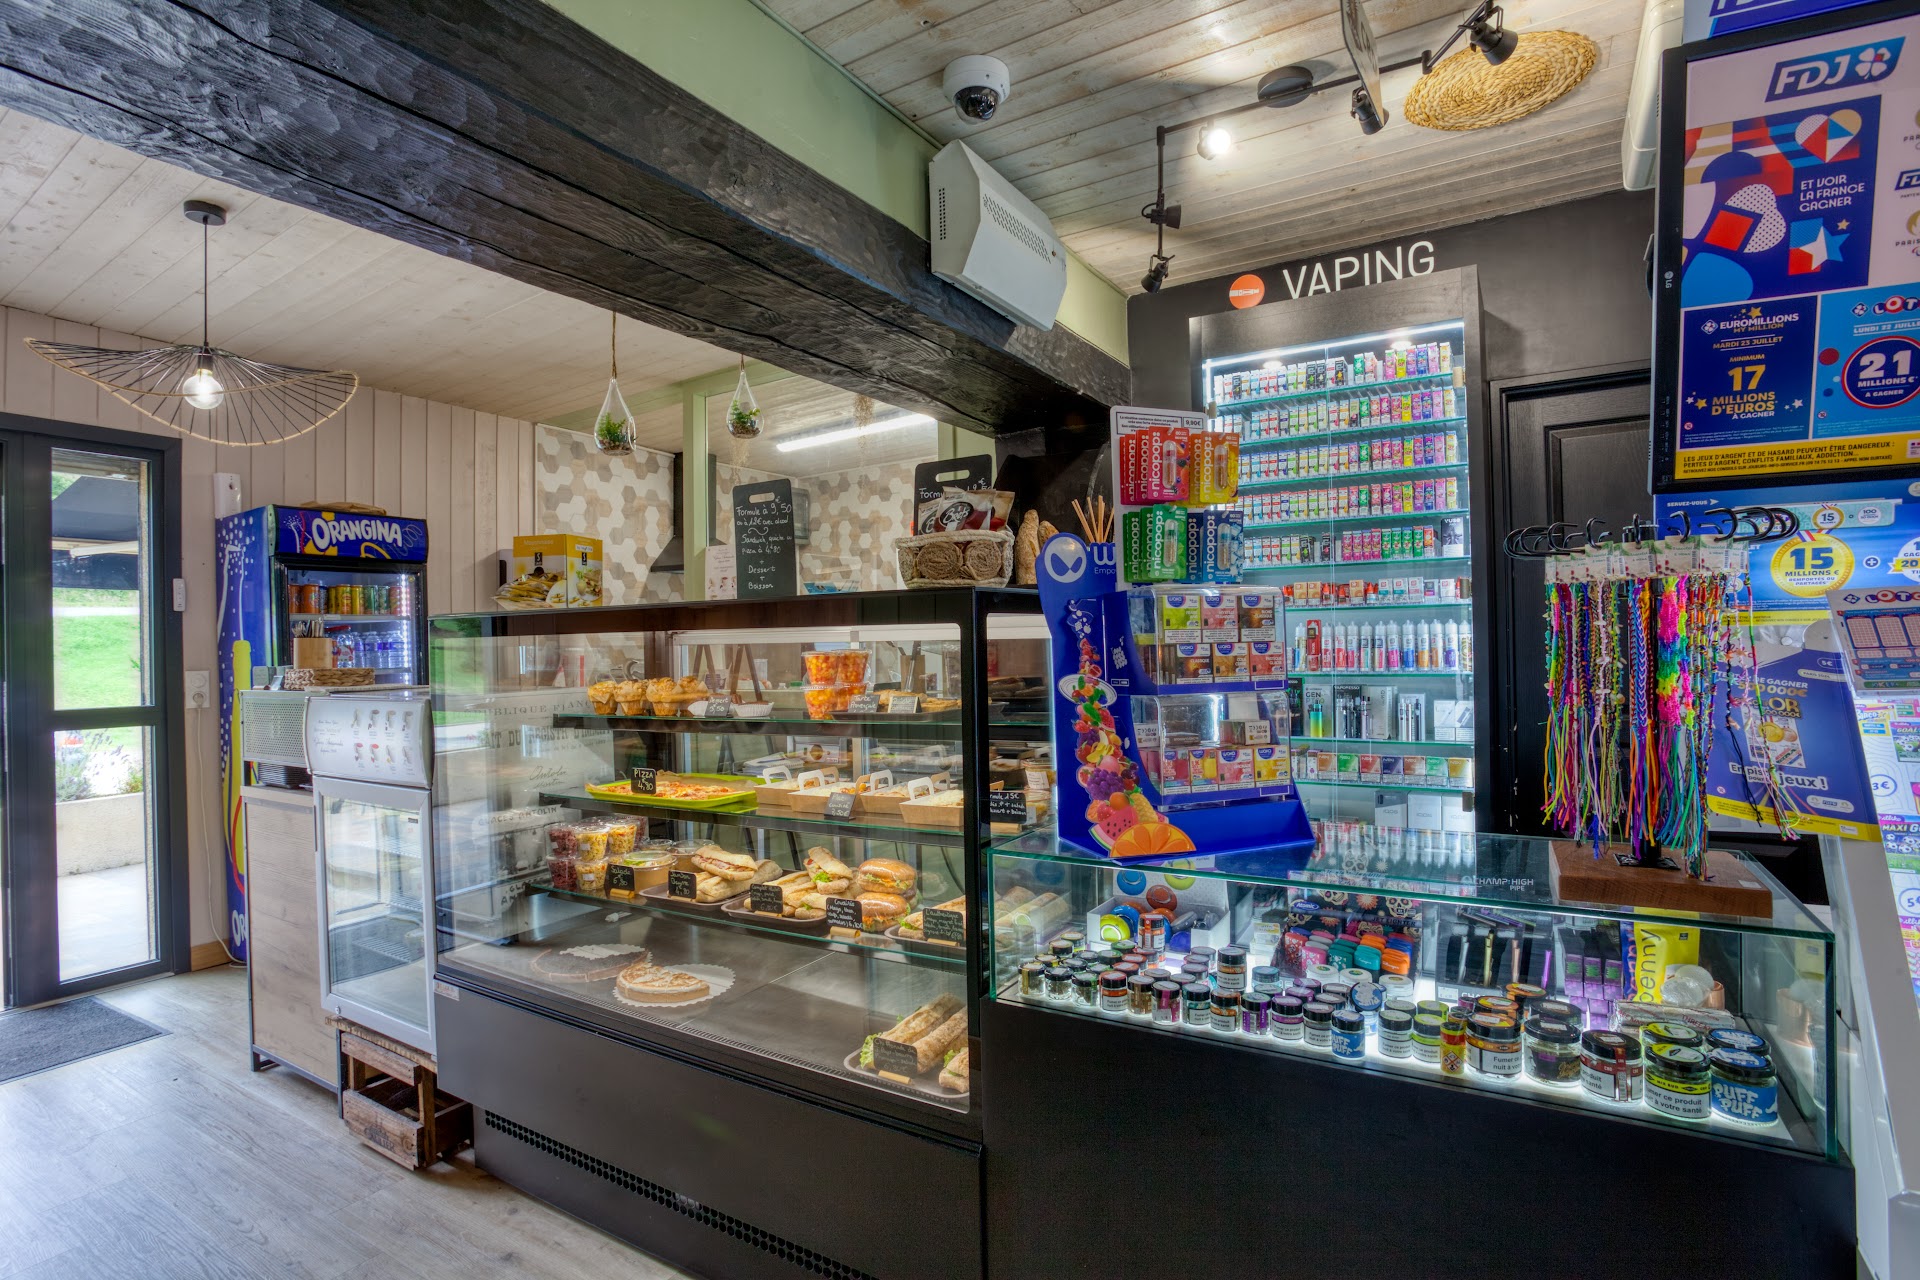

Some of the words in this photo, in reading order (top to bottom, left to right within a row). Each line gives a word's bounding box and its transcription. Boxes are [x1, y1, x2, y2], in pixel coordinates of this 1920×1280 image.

[1774, 54, 1850, 95] FDJ
[1801, 181, 1813, 190] ET
[1817, 175, 1847, 187] VOIR
[1800, 192, 1813, 201] LA
[1816, 183, 1865, 198] FRANCE
[1799, 197, 1852, 212] GAGNER
[1282, 241, 1435, 300] VAPING
[1720, 313, 1799, 329] EUROMILLIONS
[1748, 323, 1784, 331] MILLION
[1752, 336, 1783, 345] JUILLET
[1729, 354, 1765, 362] MINIMUM
[1859, 350, 1912, 379] 21
[1728, 364, 1766, 391] 17
[1857, 377, 1906, 387] MILLIONS
[1712, 392, 1775, 405] MILLIONS
[1740, 411, 1774, 419] GAGNER
[1768, 448, 1794, 456] HASARD
[1796, 446, 1827, 454] PEUVENT
[1848, 442, 1890, 450] DANGEREUX
[1776, 453, 1814, 462] FAMILIAUX,
[736, 506, 760, 516] Formule
[763, 504, 768, 514] à
[312, 518, 403, 549] ORANGINA
[1790, 547, 1834, 570] 15
[749, 565, 776, 574] Dessert
[1766, 678, 1808, 688] GAGNER
[634, 769, 654, 778] PIZZA
[1779, 773, 1818, 787] jeux
[1713, 1083, 1759, 1104] PUFF
[1661, 1102, 1680, 1113] votre
[1682, 1106, 1702, 1114] santé
[1675, 1097, 1701, 1106] produit
[1719, 1098, 1763, 1119] PUFF
